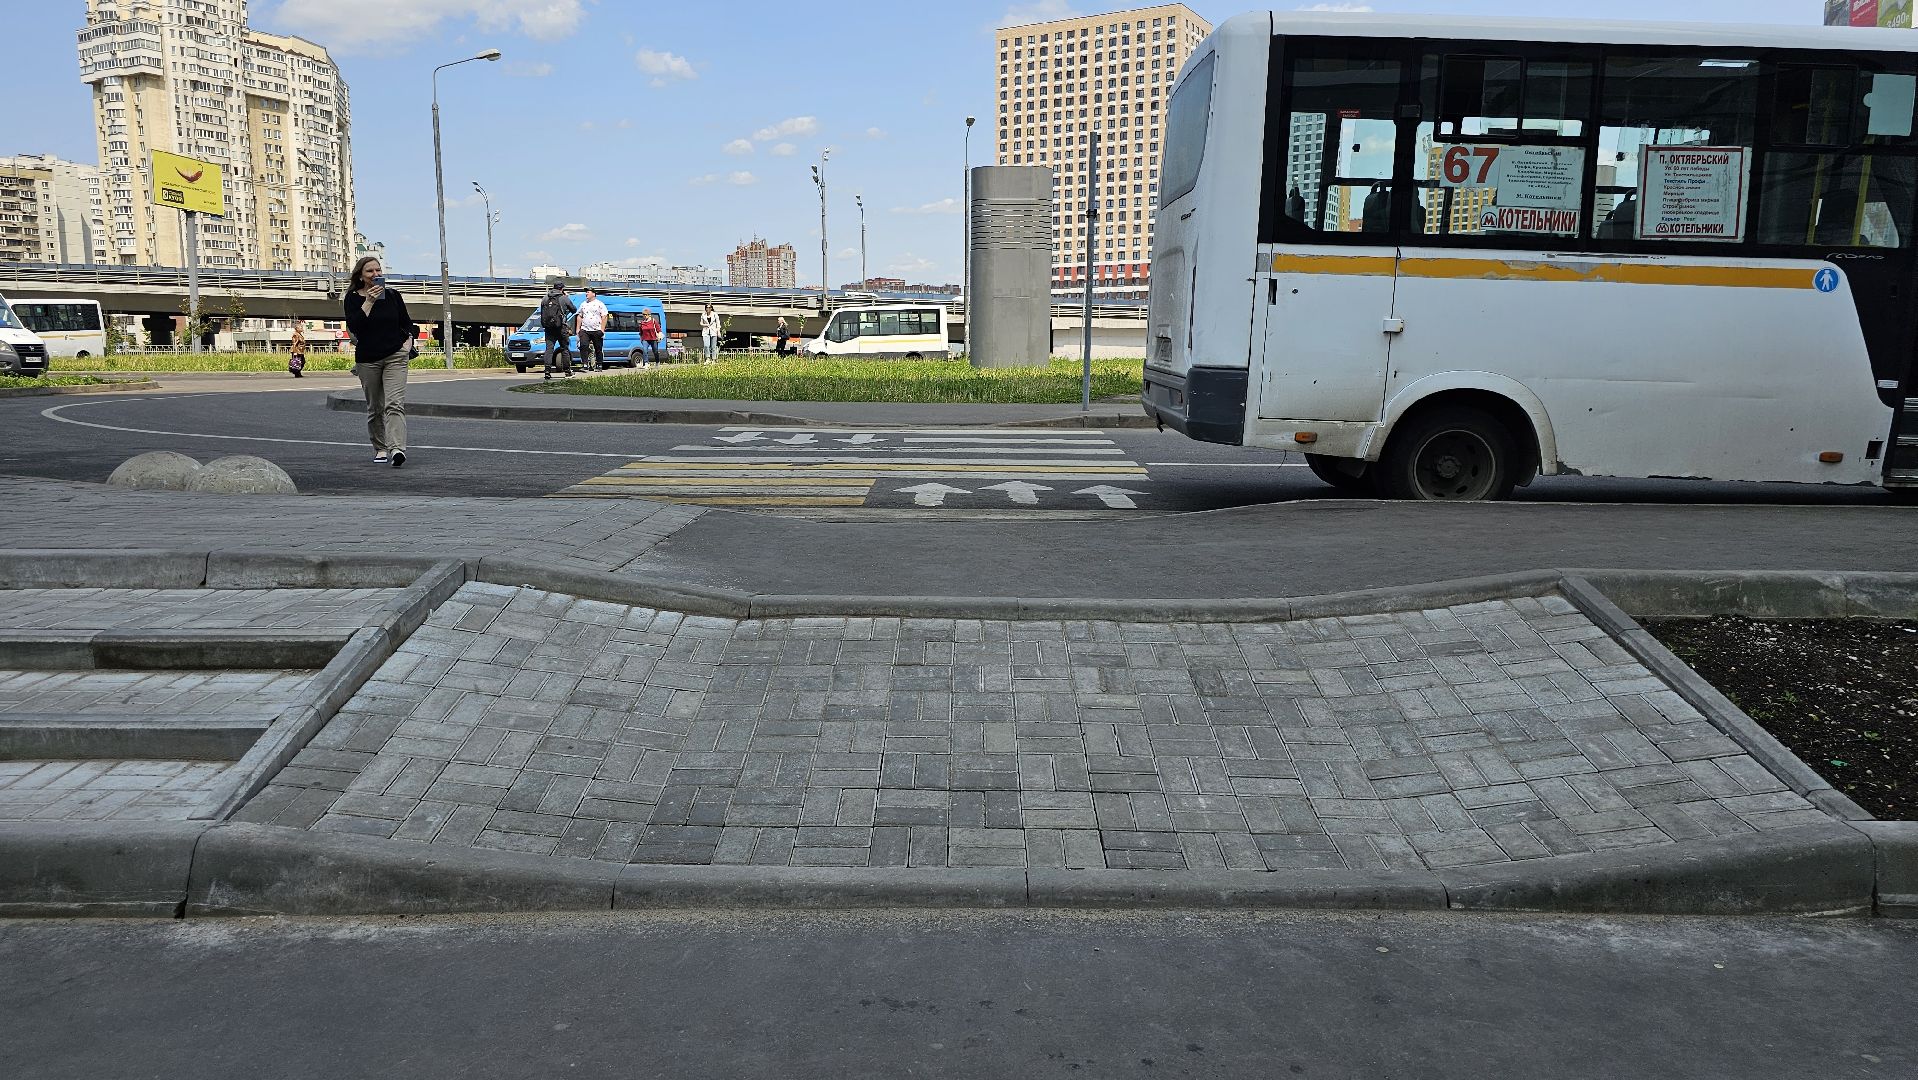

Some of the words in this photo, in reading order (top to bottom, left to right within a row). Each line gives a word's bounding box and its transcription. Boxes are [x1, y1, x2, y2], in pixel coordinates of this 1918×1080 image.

[1443, 146, 1500, 184] 67
[1660, 154, 1668, 165] П.
[1669, 152, 1730, 165] ОКТЯБРЬСКИЙ
[1497, 208, 1577, 232] КОТЕЛЬНИКИ
[1669, 223, 1725, 234] КОТЕЛЬНИКИ
